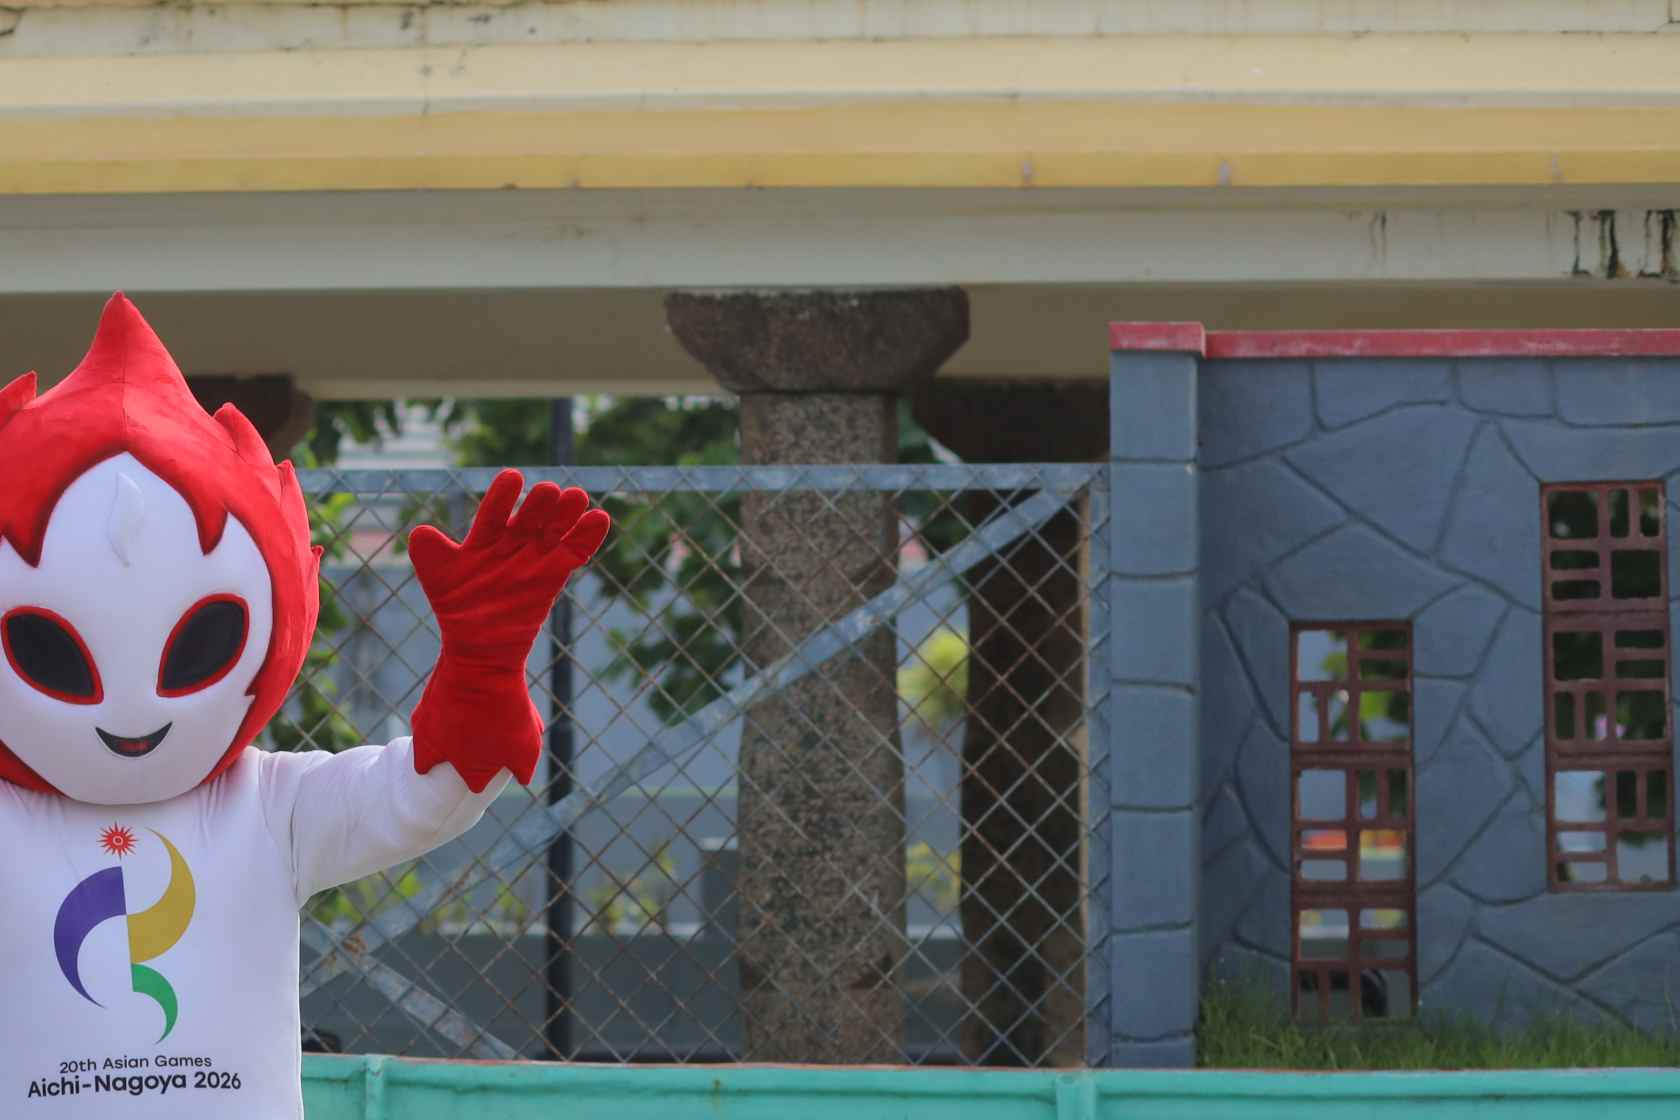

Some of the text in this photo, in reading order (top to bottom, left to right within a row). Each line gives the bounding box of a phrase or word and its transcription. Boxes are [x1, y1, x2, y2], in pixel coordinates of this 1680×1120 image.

[59, 1054, 213, 1075] 20th Asian Games
[27, 1071, 242, 1098] Aichi-Nagoya 2026
